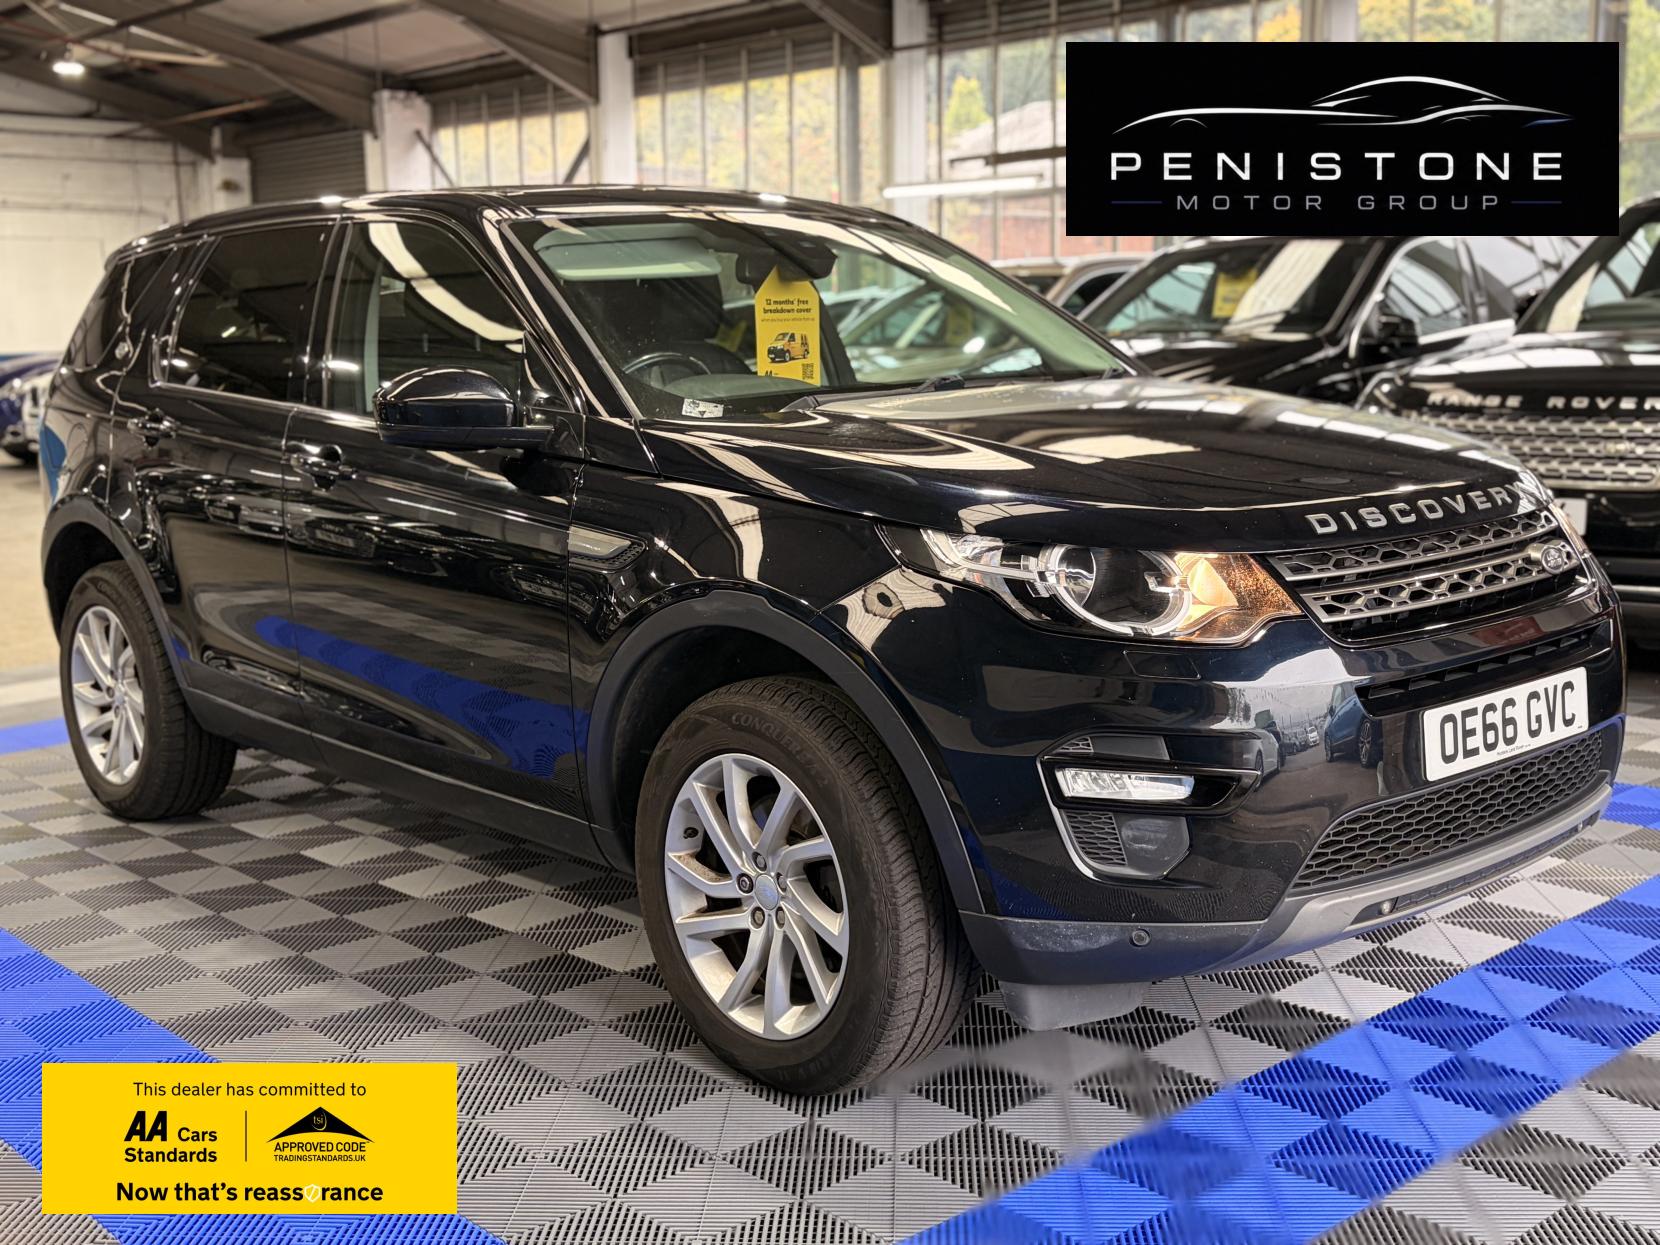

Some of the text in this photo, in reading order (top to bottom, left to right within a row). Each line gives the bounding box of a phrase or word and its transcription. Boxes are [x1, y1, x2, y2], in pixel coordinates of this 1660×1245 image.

[797, 298, 808, 306] free
[1427, 395, 1523, 408] RANGE
[1440, 680, 1576, 765] OE66 GVC
